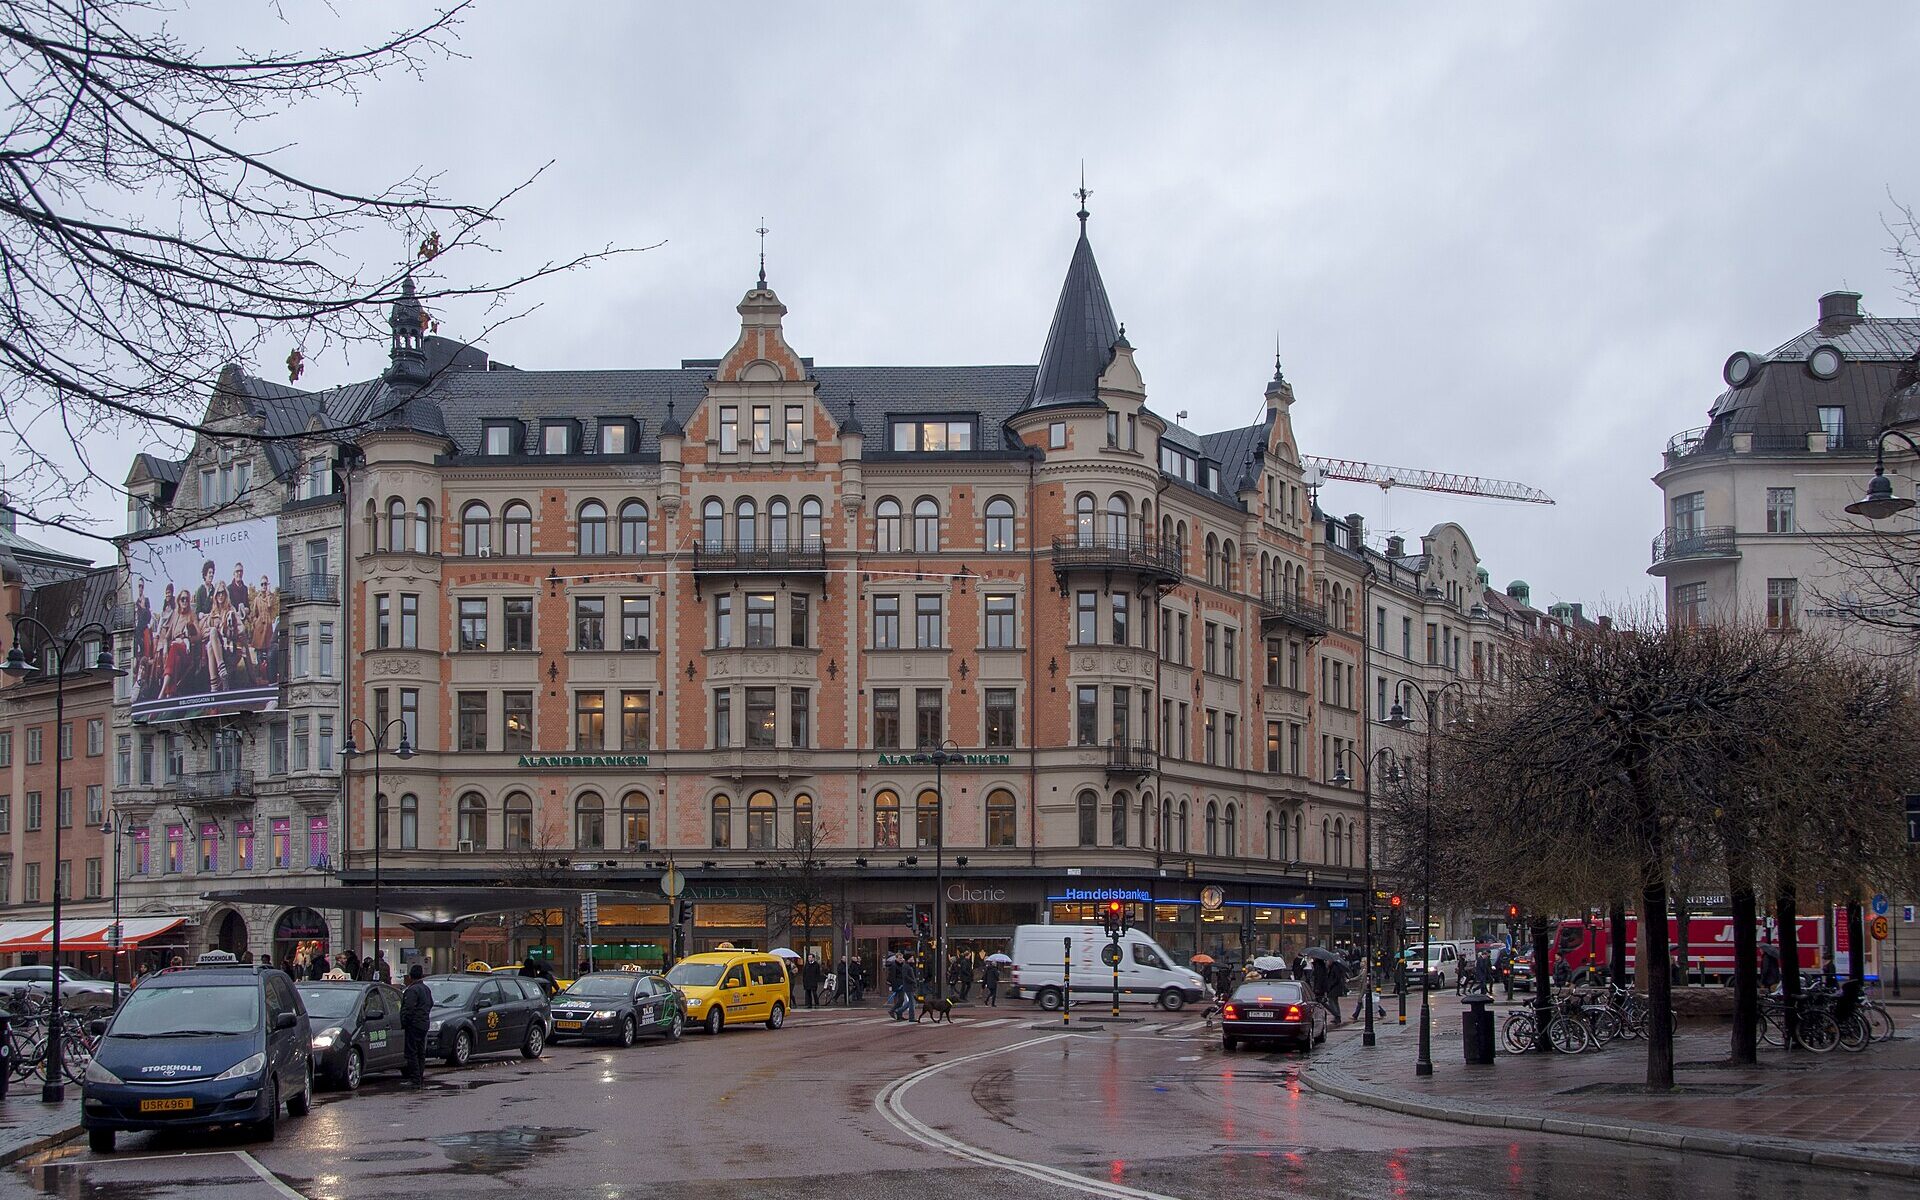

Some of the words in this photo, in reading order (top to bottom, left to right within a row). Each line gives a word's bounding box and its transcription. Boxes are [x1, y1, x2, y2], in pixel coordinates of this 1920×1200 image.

[203, 531, 249, 547] HILFIGER
[518, 755, 649, 767] ÅLANDSBANKEN
[947, 883, 1006, 902] Cherie
[1065, 888, 1149, 901] Handelsbanken
[1875, 922, 1888, 934] 50
[200, 954, 234, 963] STOCKHOLM
[141, 1065, 203, 1073] STOCKHOLM
